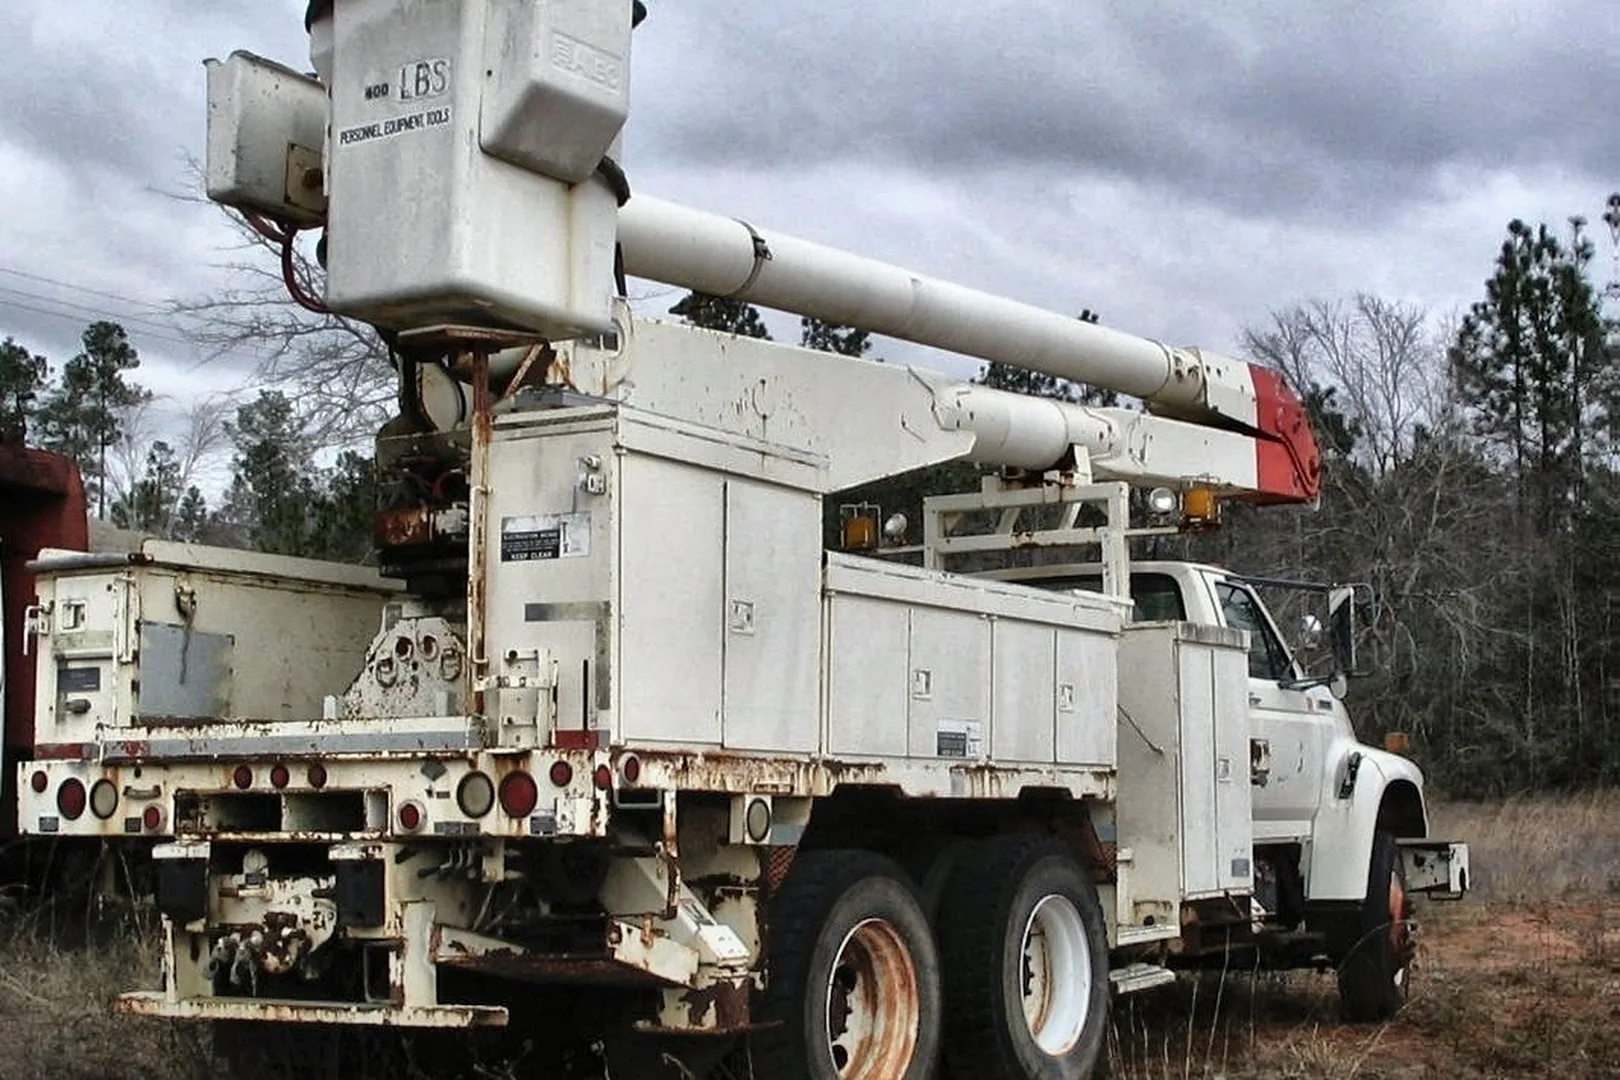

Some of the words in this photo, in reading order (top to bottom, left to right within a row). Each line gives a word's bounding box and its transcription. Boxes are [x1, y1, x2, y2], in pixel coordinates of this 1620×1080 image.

[365, 83, 389, 99] 400
[401, 60, 446, 99] LBS
[427, 108, 449, 126] TOOLS
[531, 551, 552, 559] CLEAR
